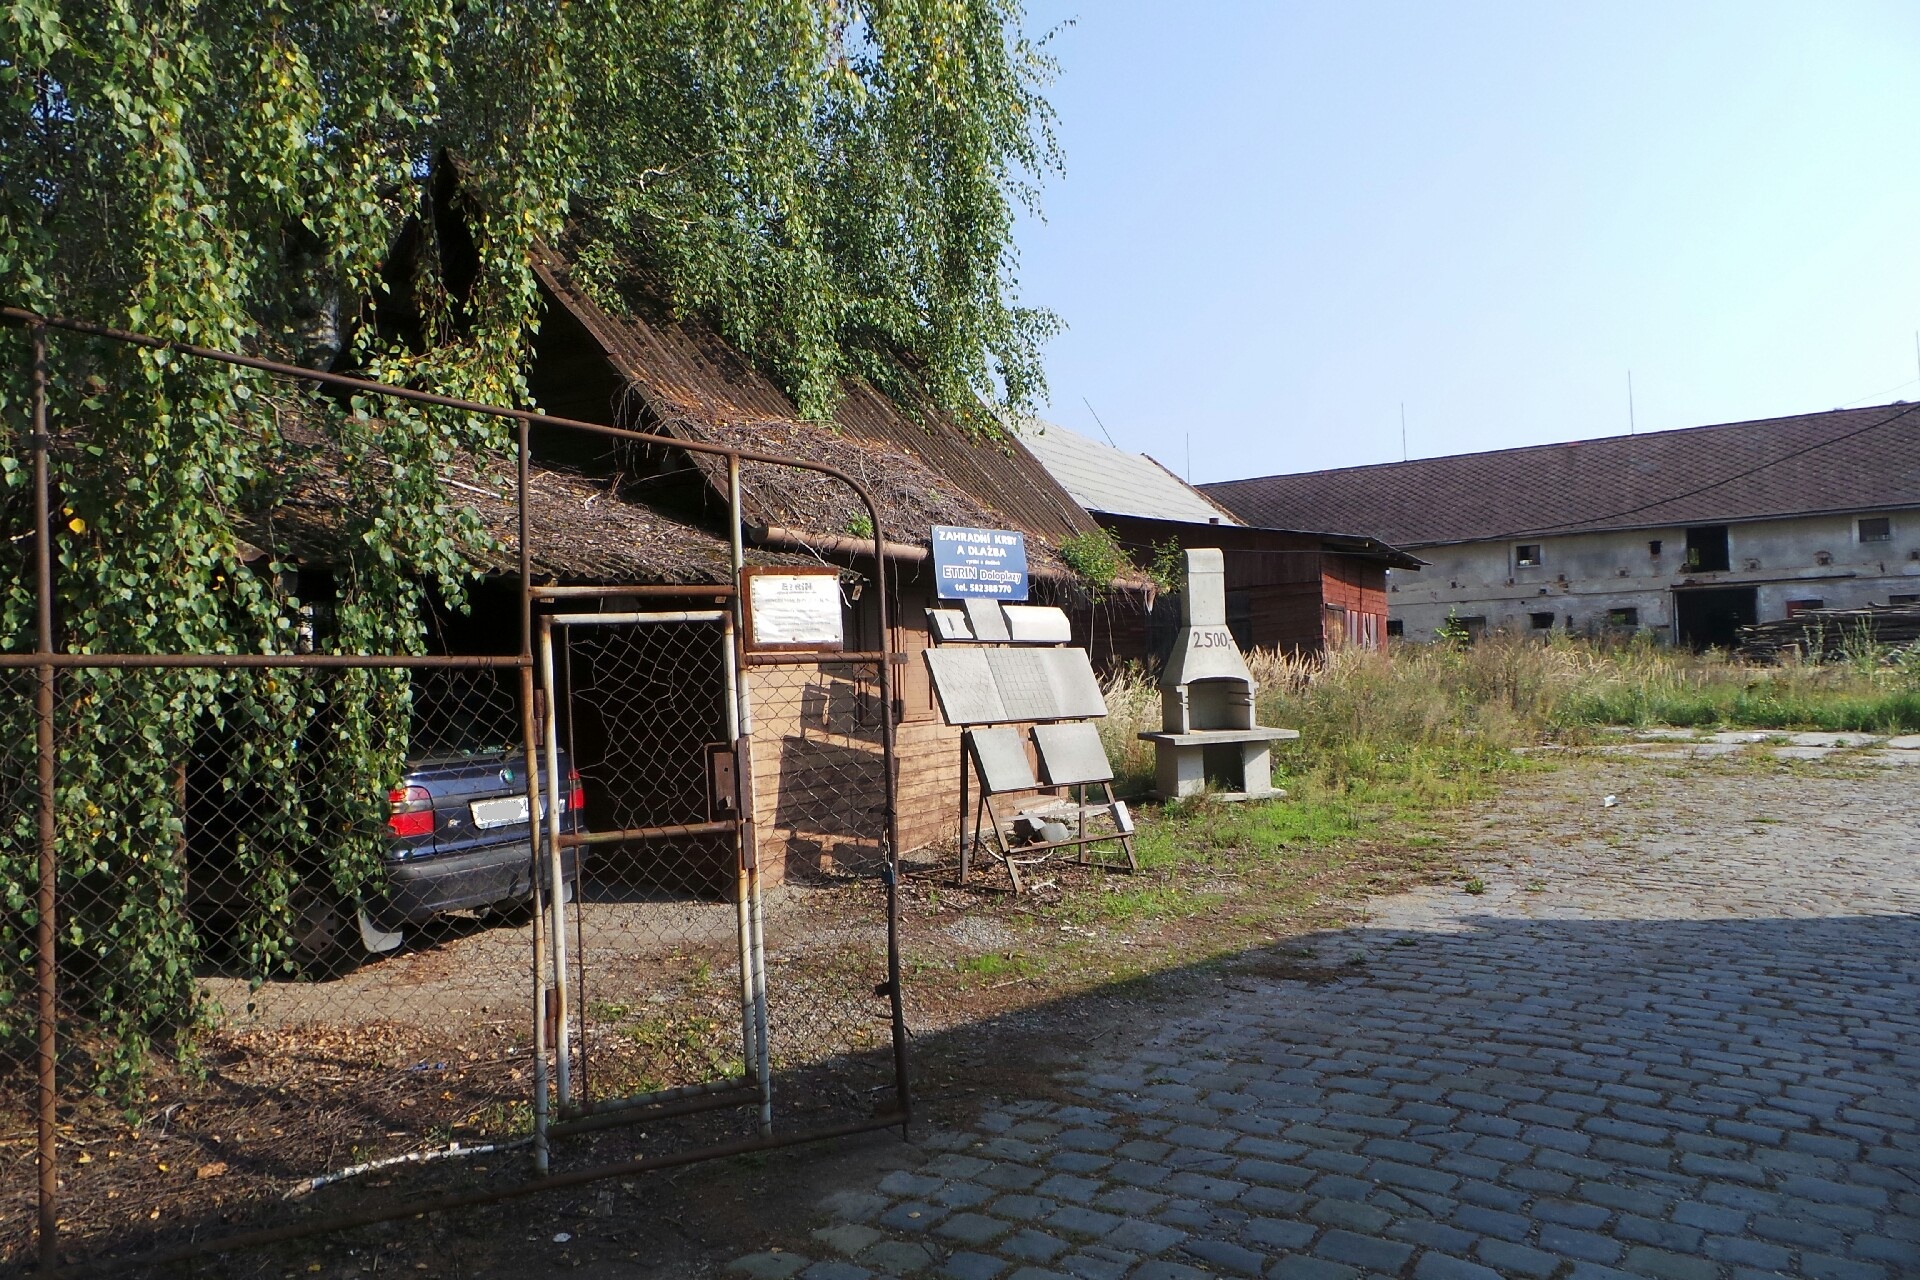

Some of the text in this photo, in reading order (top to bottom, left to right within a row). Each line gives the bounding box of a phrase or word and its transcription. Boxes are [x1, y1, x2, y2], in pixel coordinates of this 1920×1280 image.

[938, 531, 1017, 545] ZAHRADNÍ KRBY
[956, 545, 1007, 557] A DLAŽBA
[943, 566, 1022, 584] ETRIN Doloplazy
[954, 583, 968, 592] tel.
